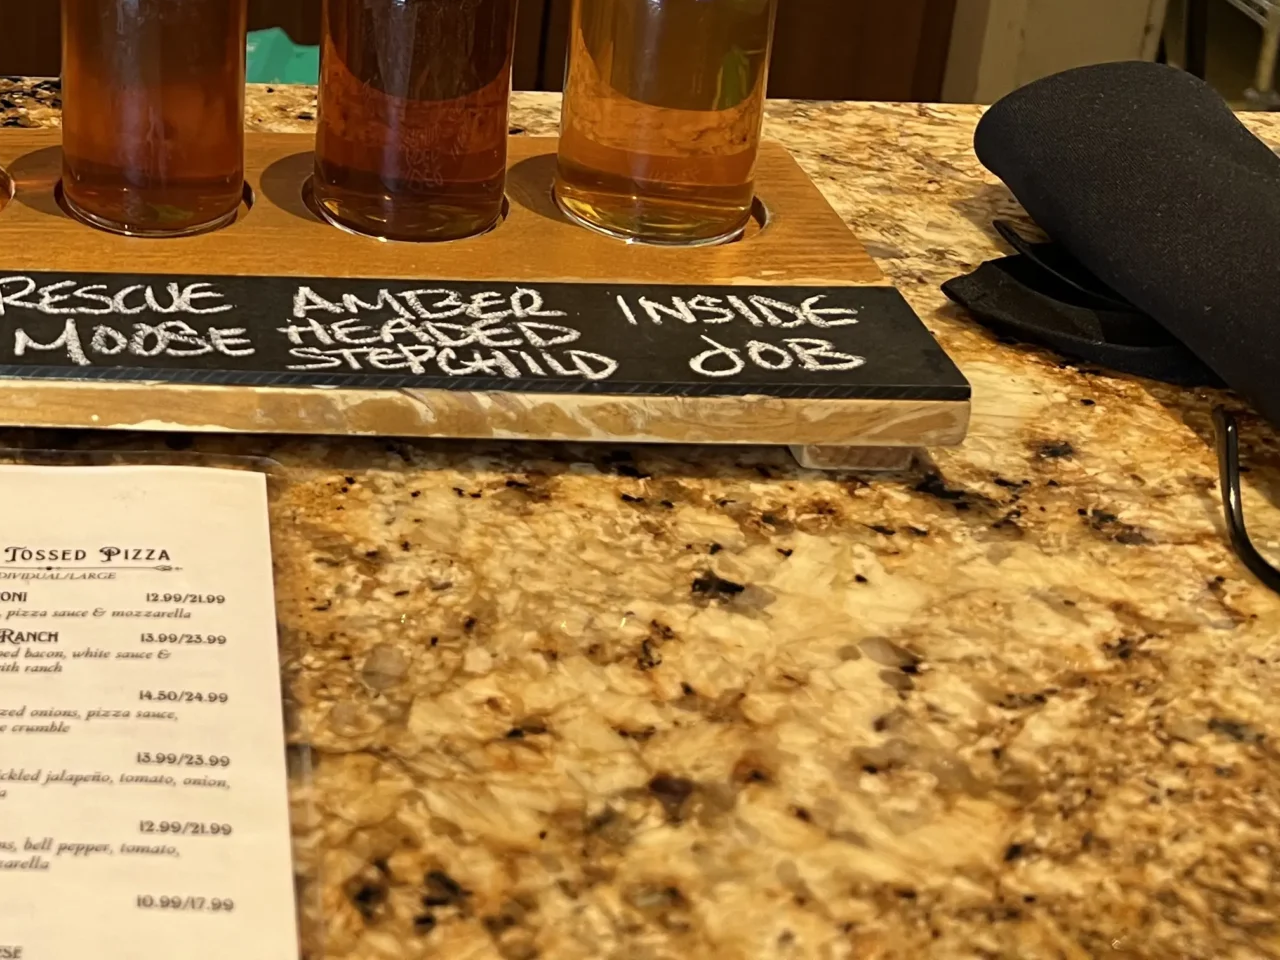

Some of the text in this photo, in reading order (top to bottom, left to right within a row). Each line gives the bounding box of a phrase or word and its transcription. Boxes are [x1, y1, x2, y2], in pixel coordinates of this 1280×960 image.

[291, 286, 568, 320] AMBER
[615, 293, 866, 330] INSIDE
[14, 318, 256, 366] MOOSE
[277, 314, 581, 349] HEADED
[286, 342, 620, 382] STEPCHILD
[688, 334, 868, 379] JOB
[4, 546, 87, 562] TOSSED
[98, 545, 170, 562] PIZZA
[145, 591, 225, 604] 12.99/21.99
[4, 607, 48, 620] pizza
[50, 609, 89, 618] sauce
[91, 606, 107, 617] &
[110, 607, 192, 619] mozzarella
[138, 689, 228, 703] 14.50/24.99
[138, 819, 233, 836] 12.99/21.99
[135, 894, 234, 913] 10.99/17.99
